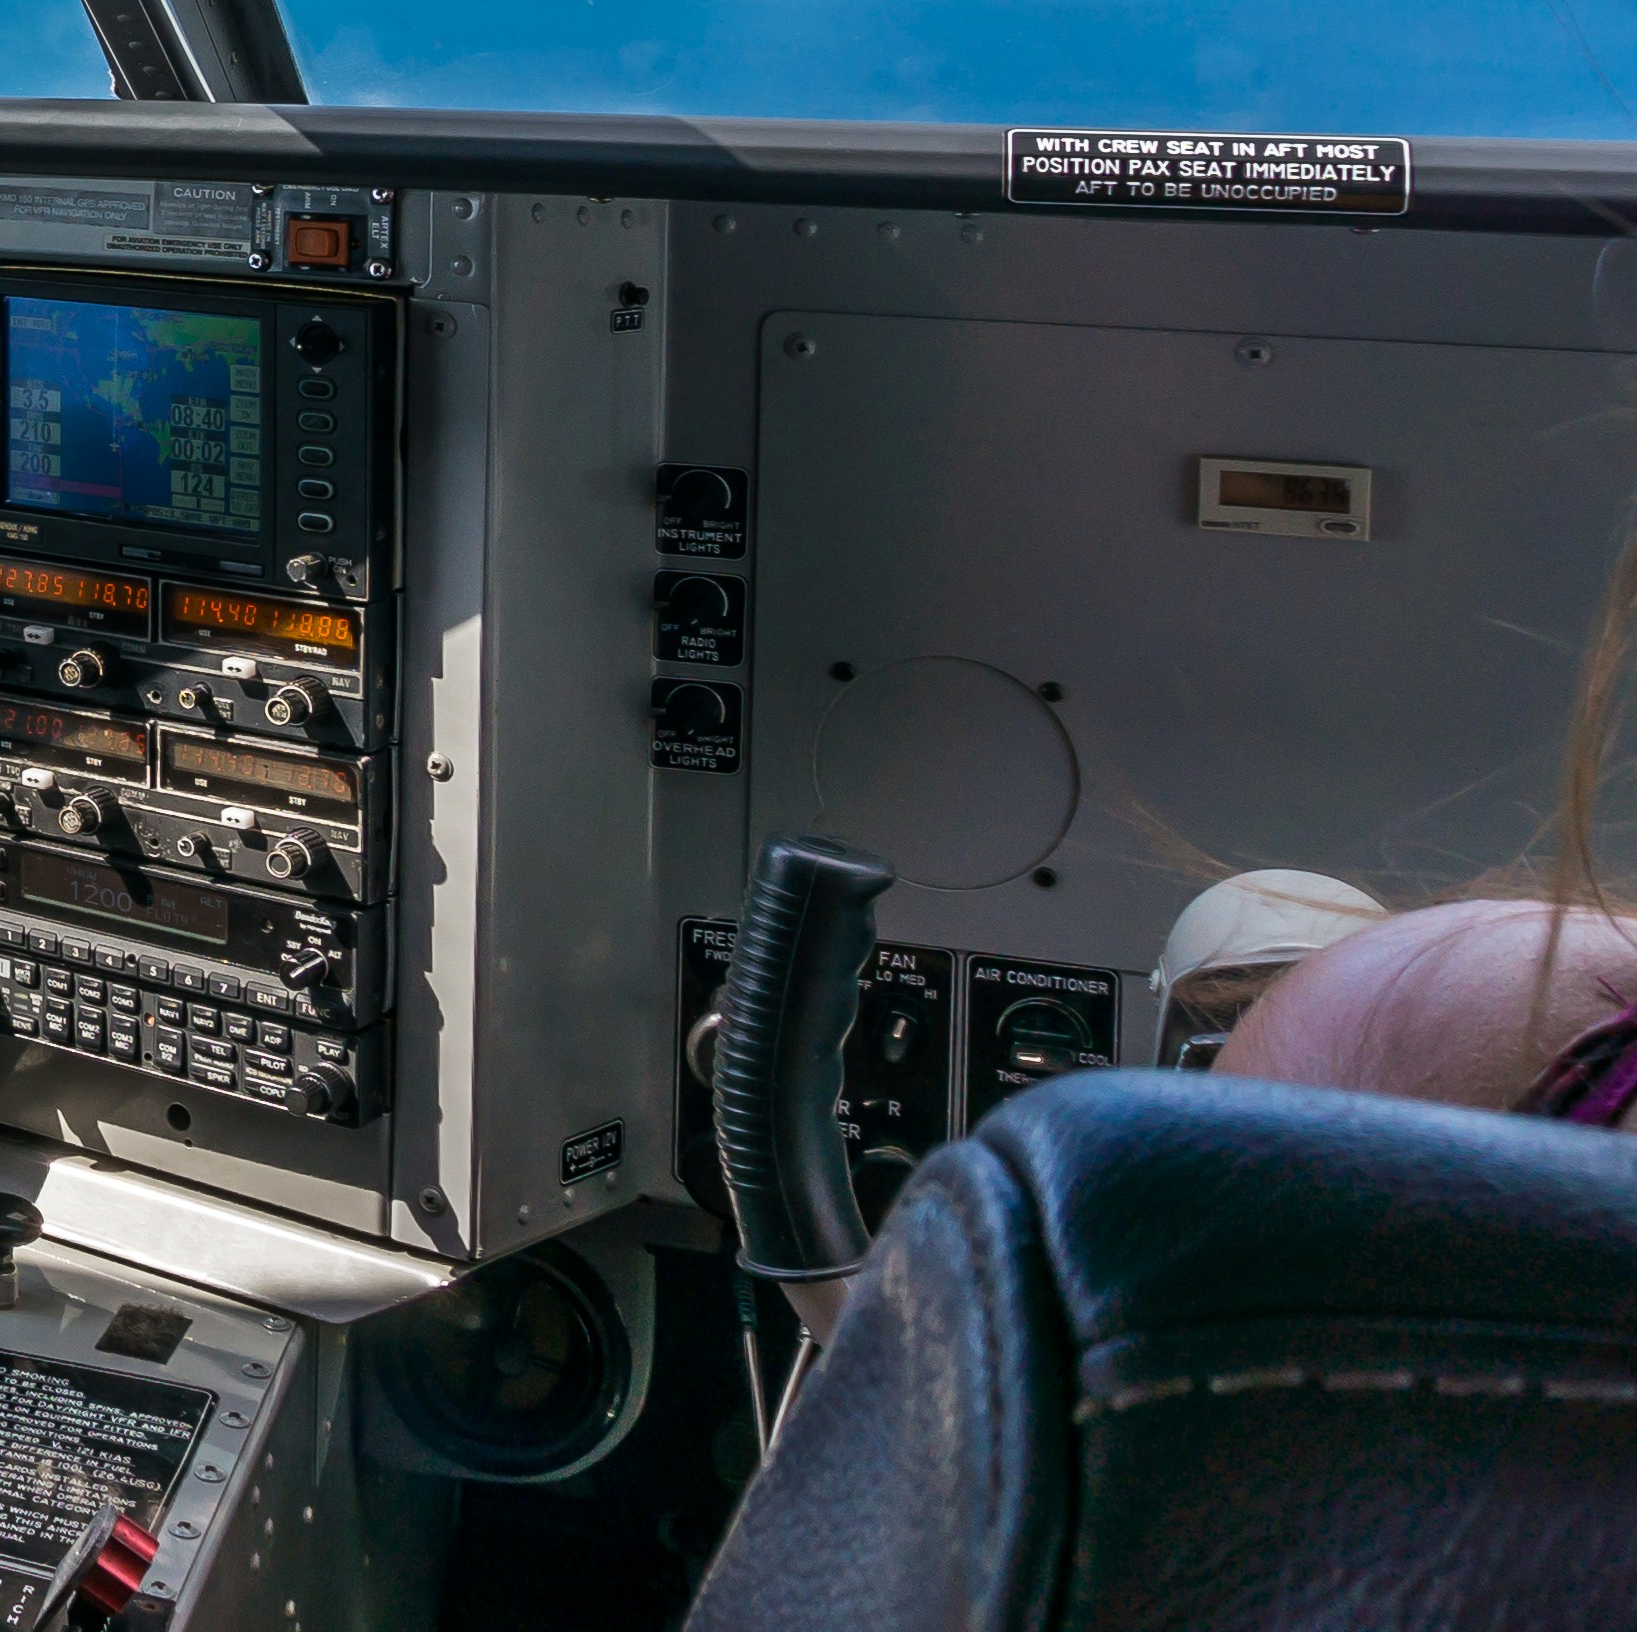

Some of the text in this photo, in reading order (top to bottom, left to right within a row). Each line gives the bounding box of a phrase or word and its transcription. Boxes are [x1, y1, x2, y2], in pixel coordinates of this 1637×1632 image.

[1036, 138, 1379, 159] WITH CREW SEAT IN AFT MOST
[1022, 157, 1395, 182] POSITION PAX SEAT IMMEDIATELY
[174, 188, 236, 200] CAUTION
[1075, 181, 1337, 202] AFT TO BE UNOCCUPIED
[380, 216, 389, 249] ARTEX
[173, 406, 223, 430] 08:40
[20, 421, 51, 442] 210
[173, 439, 223, 462] 00:02
[181, 475, 214, 495] 124
[658, 529, 742, 543] INSTRUMENT
[679, 543, 720, 554] LIGHTS
[681, 636, 716, 648] RADIO
[678, 649, 718, 661] LIGHTS
[332, 677, 351, 687] NAV
[653, 741, 736, 757] OVERHEAD
[670, 756, 717, 768] LIGHTS
[70, 880, 132, 912] 1200
[879, 951, 916, 969] FAN
[47, 978, 68, 991] COM1
[876, 970, 937, 1000] LO MED HI
[975, 967, 1109, 995] AIR CONDITIONER
[79, 987, 101, 999] COM2
[257, 992, 277, 1006] ENT
[264, 1035, 282, 1046] ADF
[211, 1045, 226, 1056] TEL
[318, 1045, 341, 1058] PLAY
[261, 1058, 285, 1071] PILOT
[207, 1072, 230, 1084] SPKR
[11, 1369, 70, 1387] SMOKING
[4, 1377, 17, 1385] TO
[22, 1381, 36, 1389] BE
[42, 1384, 86, 1399] CLOSED.
[40, 1472, 109, 1493] INSTALLED
[32, 1495, 98, 1517] CATEGORY
[6, 1583, 35, 1626] RICH
